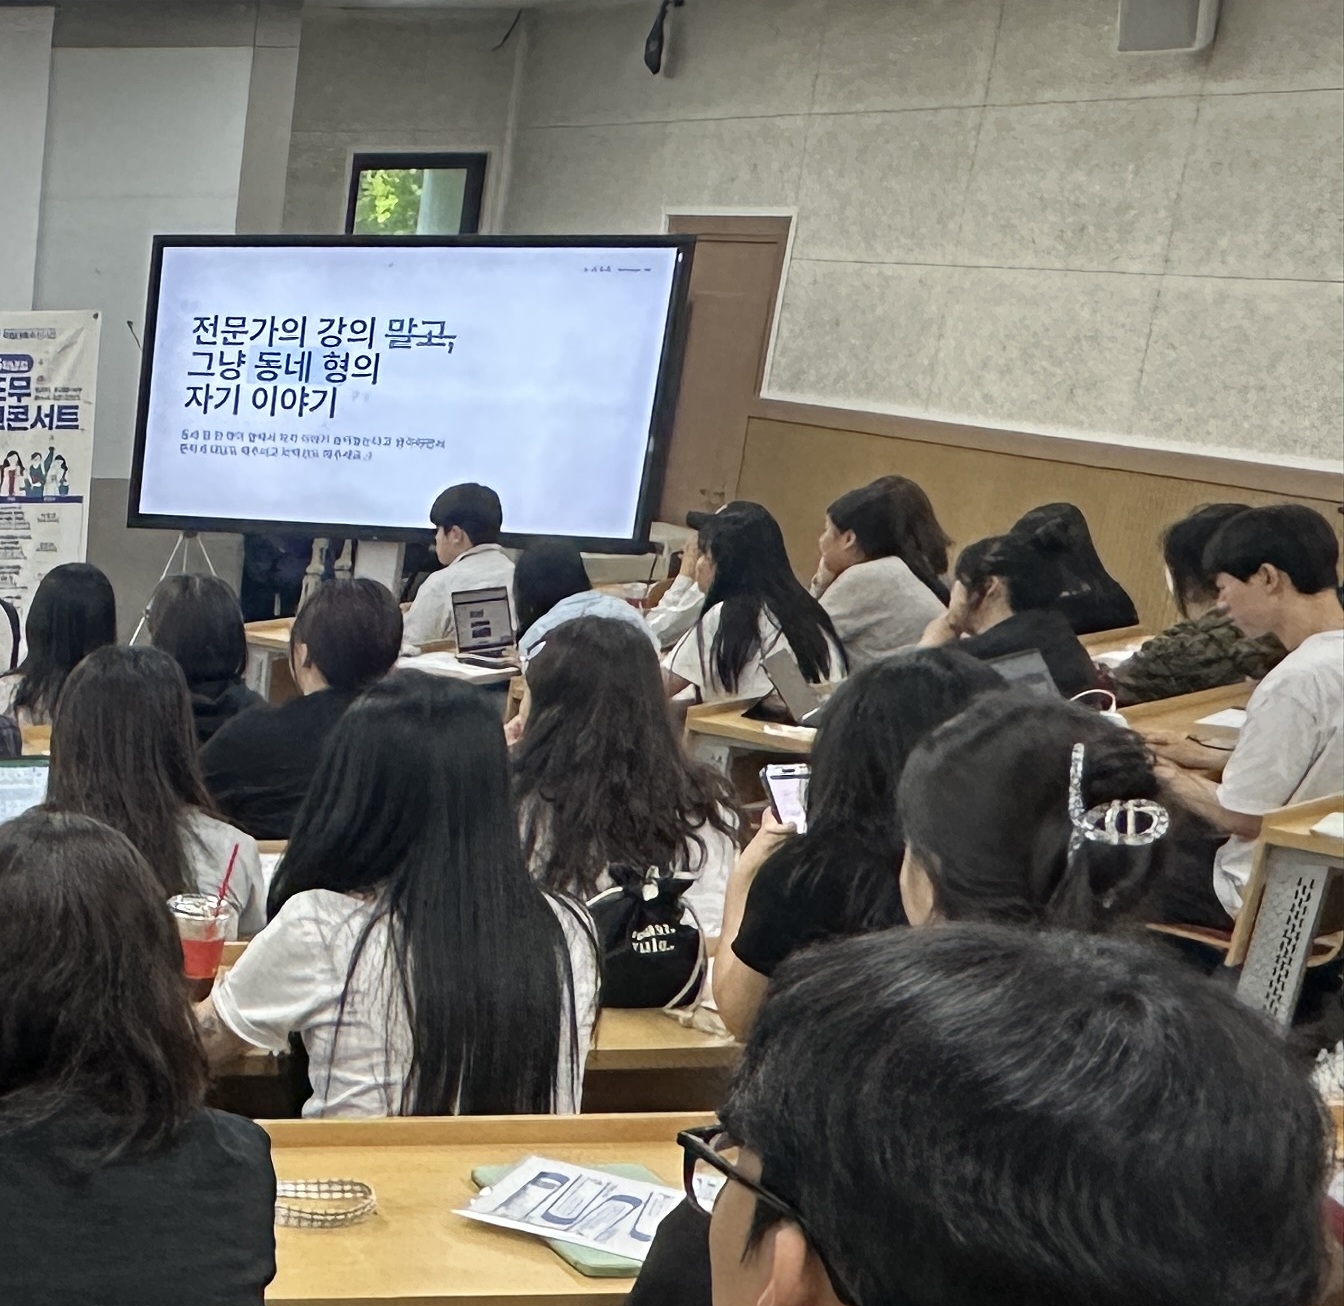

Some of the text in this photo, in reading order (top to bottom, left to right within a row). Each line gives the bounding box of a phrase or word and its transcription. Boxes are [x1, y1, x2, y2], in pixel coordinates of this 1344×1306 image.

[192, 315, 458, 355] 전문가의 강의 말고,
[187, 349, 381, 386] 그냥 동네 형의
[184, 383, 338, 419] 자기 이야기
